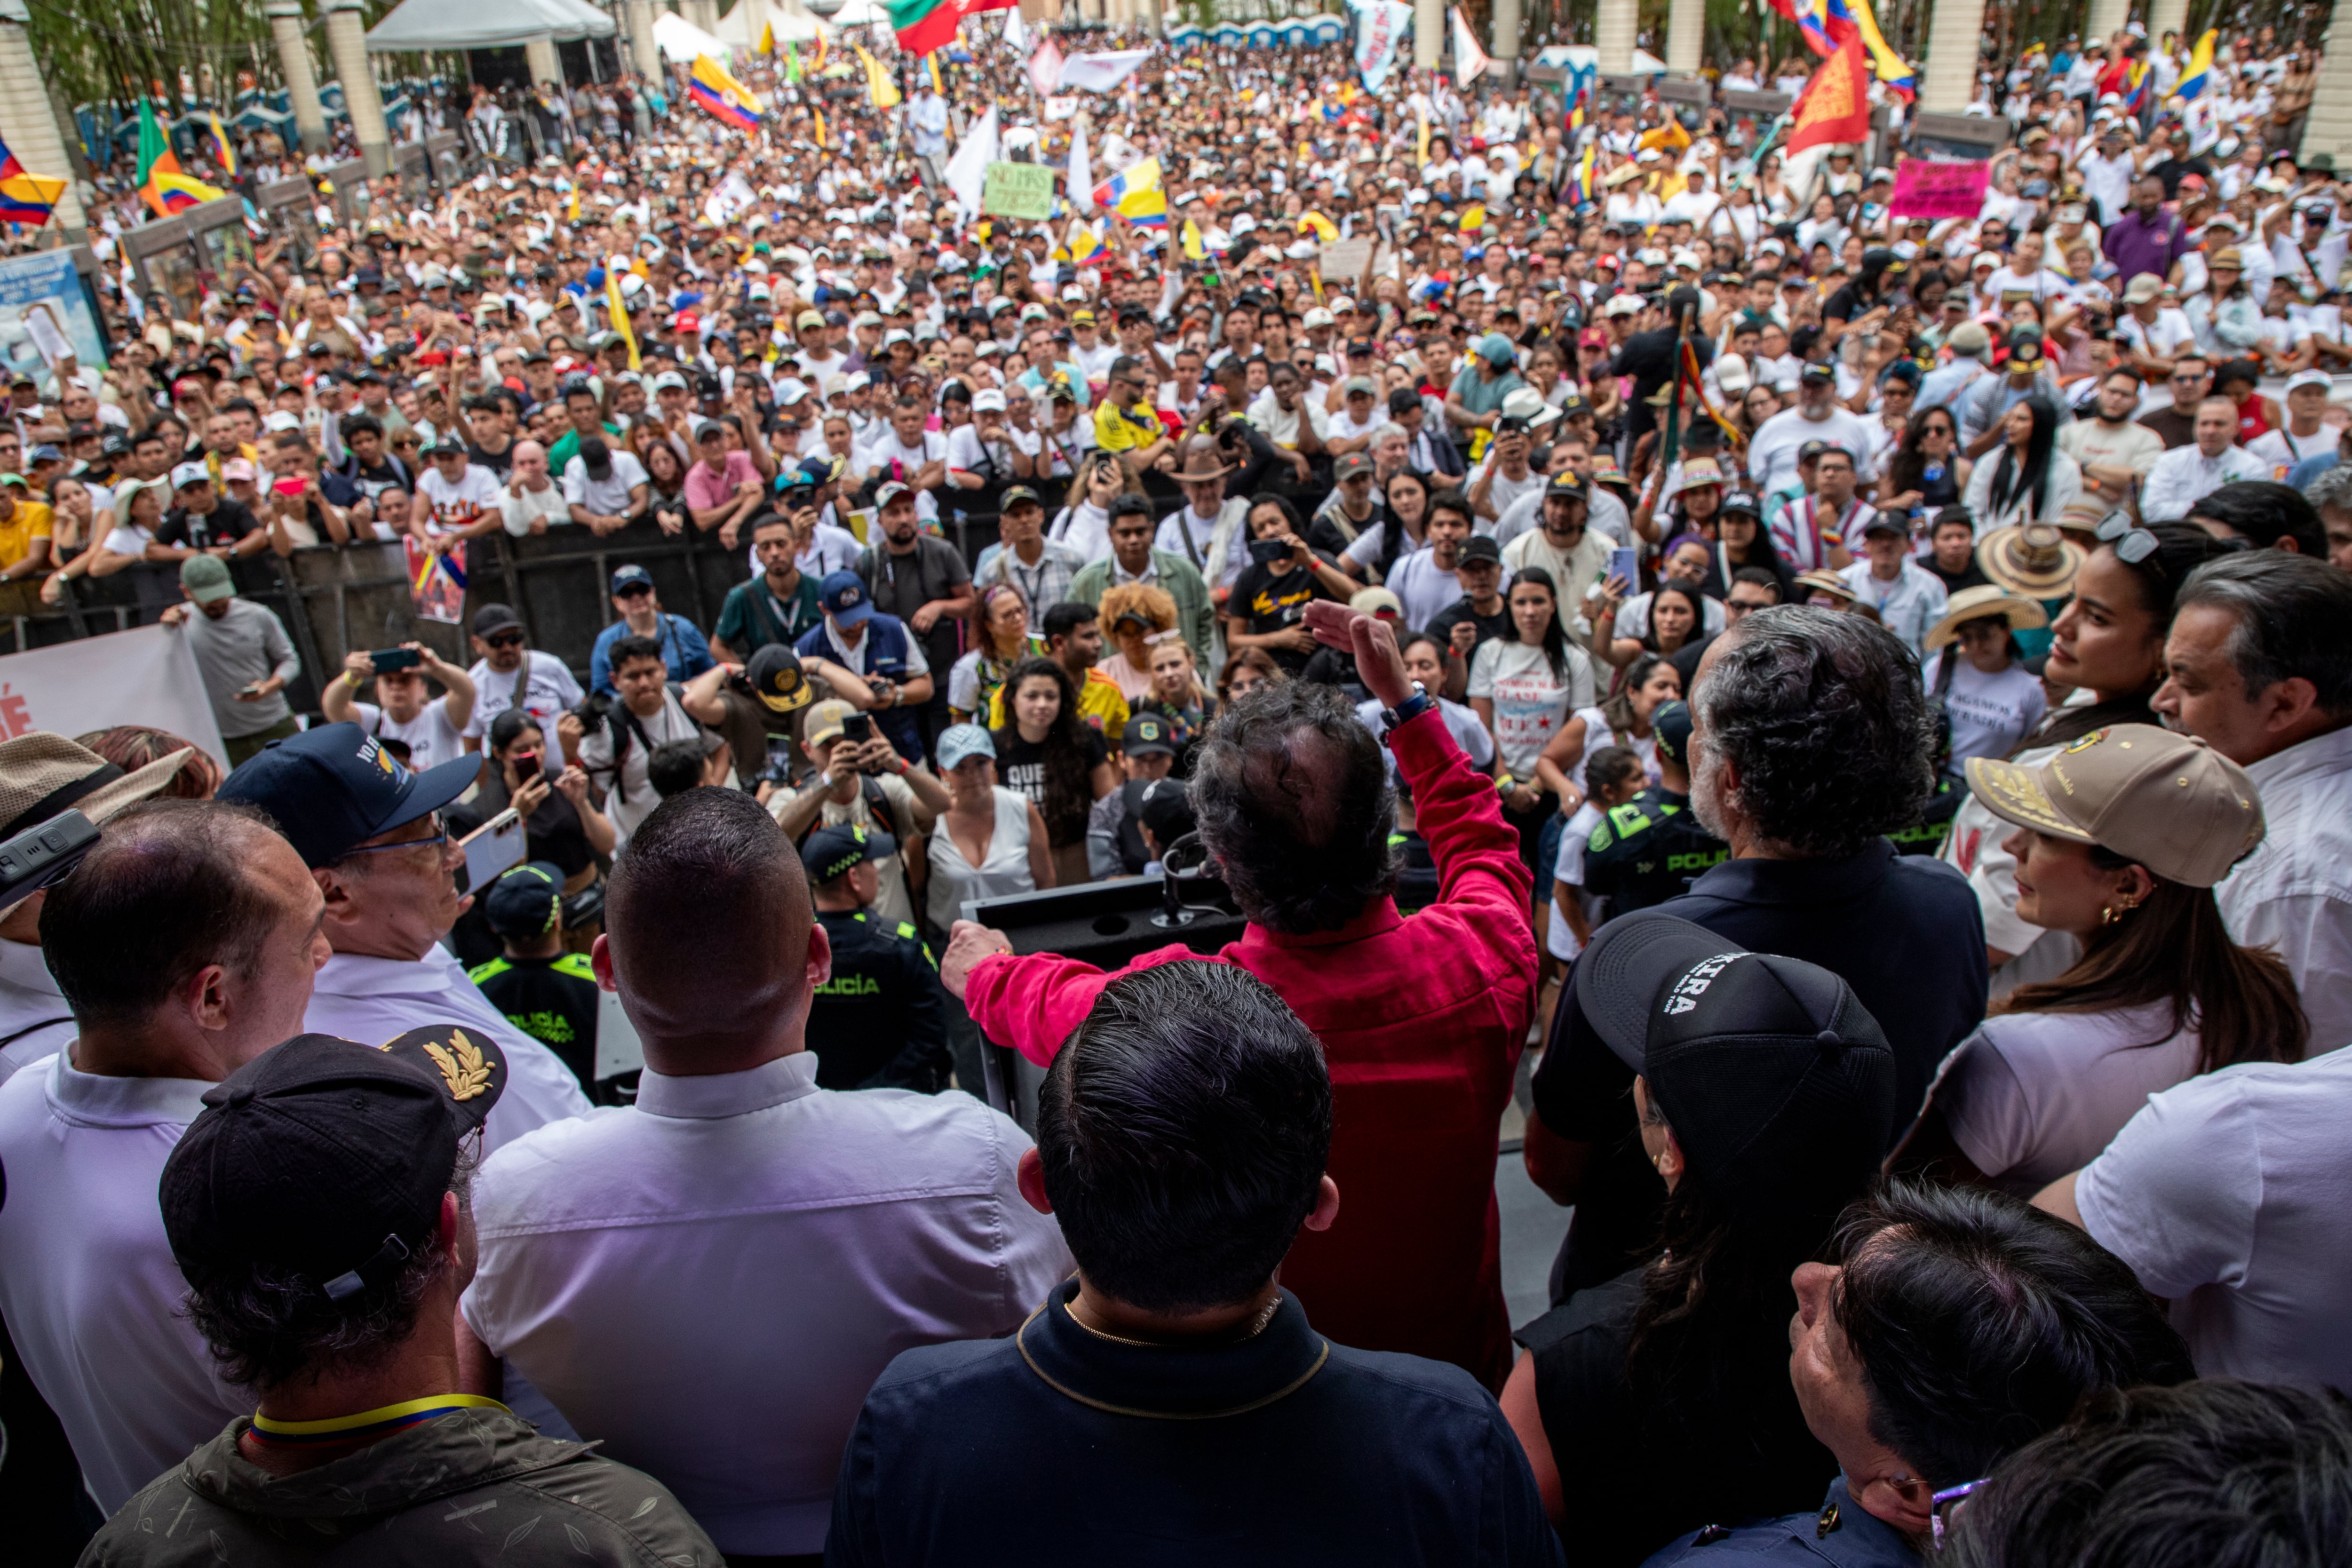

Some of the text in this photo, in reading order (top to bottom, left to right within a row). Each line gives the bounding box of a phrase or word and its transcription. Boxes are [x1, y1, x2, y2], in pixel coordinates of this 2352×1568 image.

[356, 744, 376, 764] YO
[814, 972, 881, 995] LICÍA
[1663, 995, 1676, 1013] TOUR
